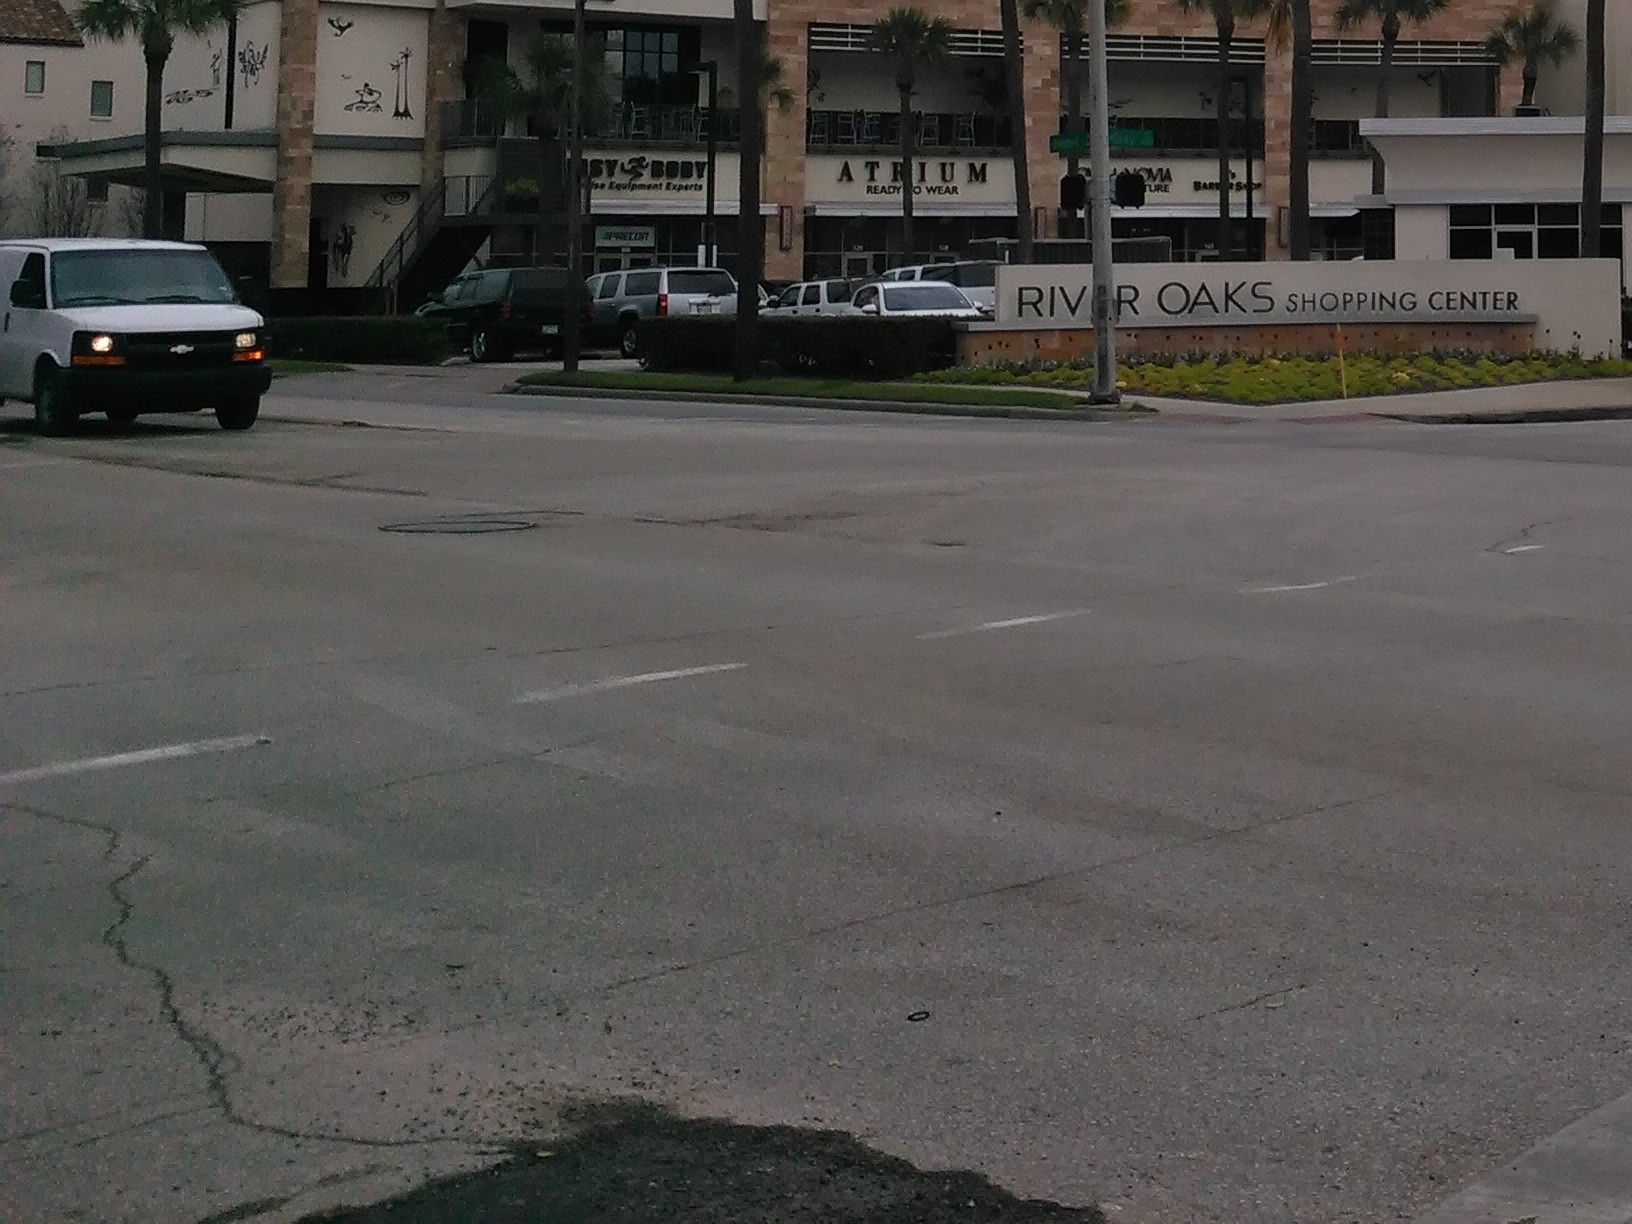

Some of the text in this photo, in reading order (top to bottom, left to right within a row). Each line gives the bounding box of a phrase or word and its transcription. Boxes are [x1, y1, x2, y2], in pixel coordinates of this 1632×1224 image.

[837, 160, 989, 184] ATRIUM
[609, 181, 663, 192] Equipment
[666, 182, 703, 192] Experts
[866, 185, 903, 195] READY
[925, 185, 959, 195] WEAR
[1016, 280, 1520, 318] RIVR OAKS SHOPPING CENTER
